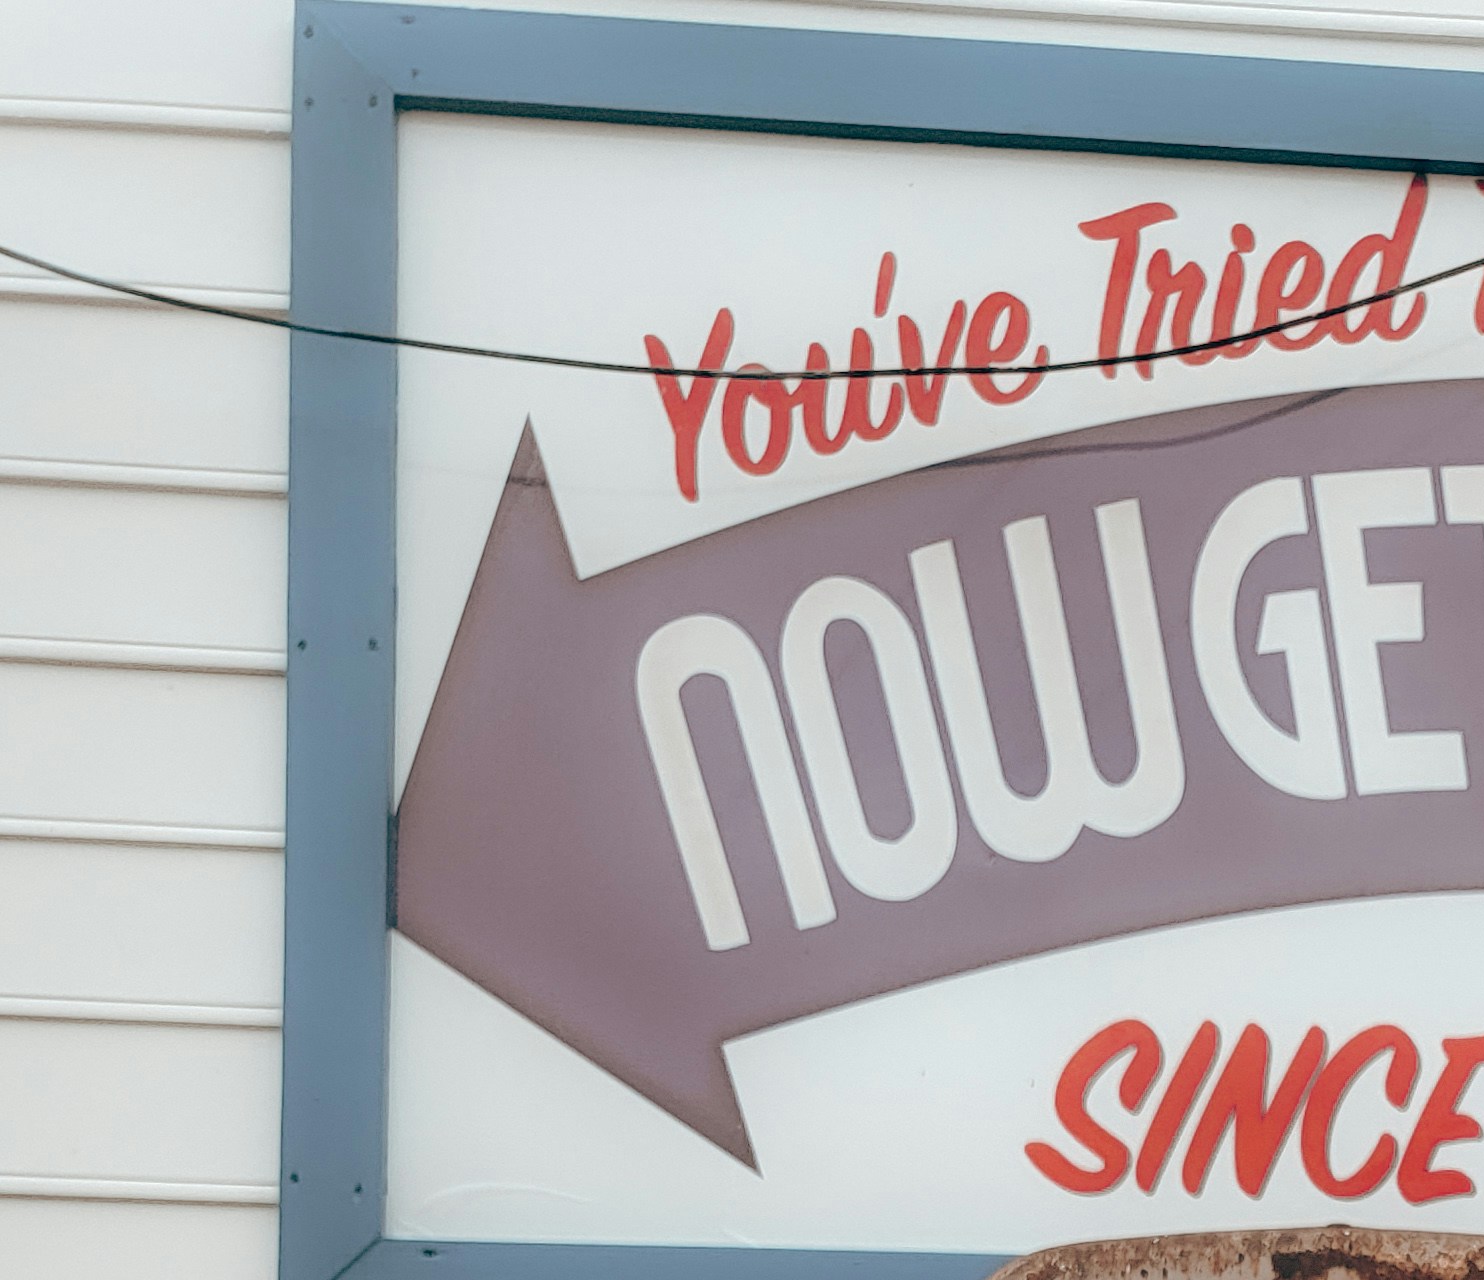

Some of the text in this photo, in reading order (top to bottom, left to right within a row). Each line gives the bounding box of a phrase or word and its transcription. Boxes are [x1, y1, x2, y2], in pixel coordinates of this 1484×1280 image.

[643, 251, 1049, 503] You've
[1078, 173, 1427, 381] Tried
[635, 498, 1186, 951] NOW
